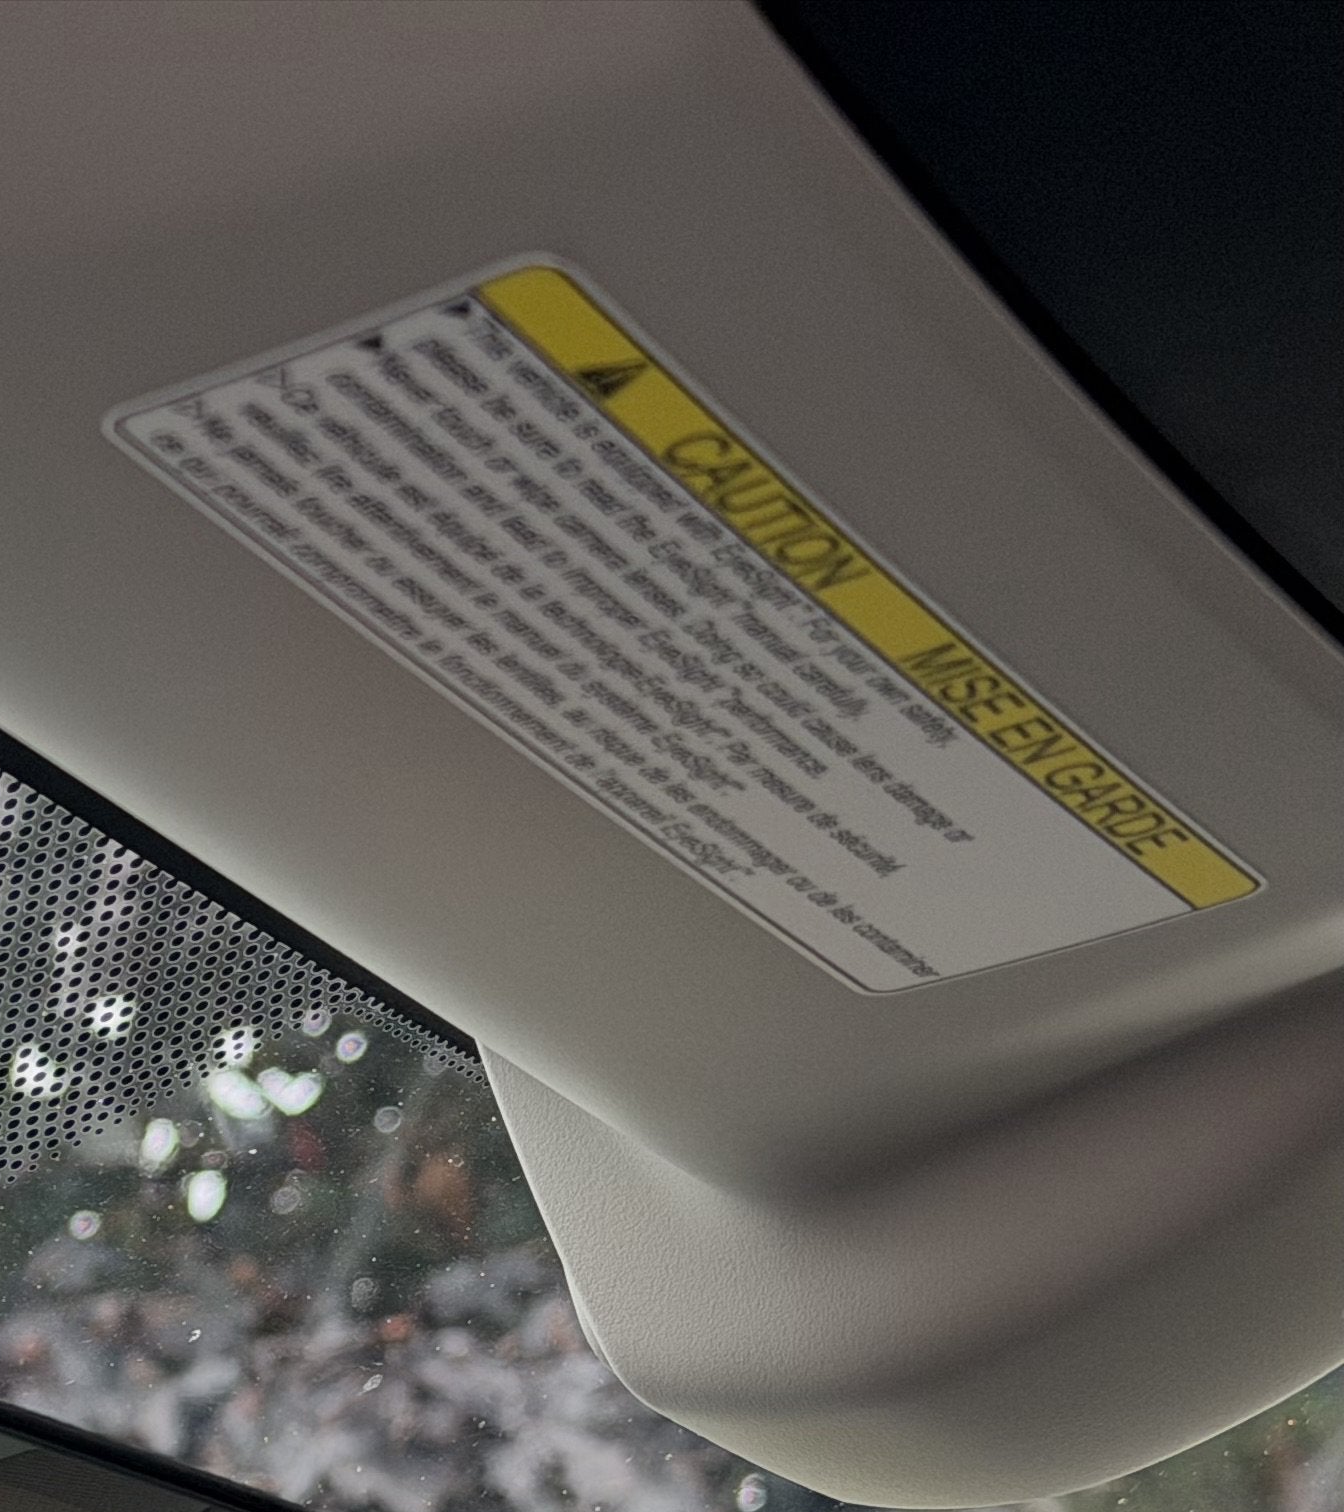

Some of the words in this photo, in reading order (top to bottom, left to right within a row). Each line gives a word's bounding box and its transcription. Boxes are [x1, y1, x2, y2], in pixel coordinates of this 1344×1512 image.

[653, 427, 875, 593] CAUTION
[896, 640, 1030, 724] MISE
[984, 715, 1080, 766] EN
[1037, 758, 1194, 856] GARDE
